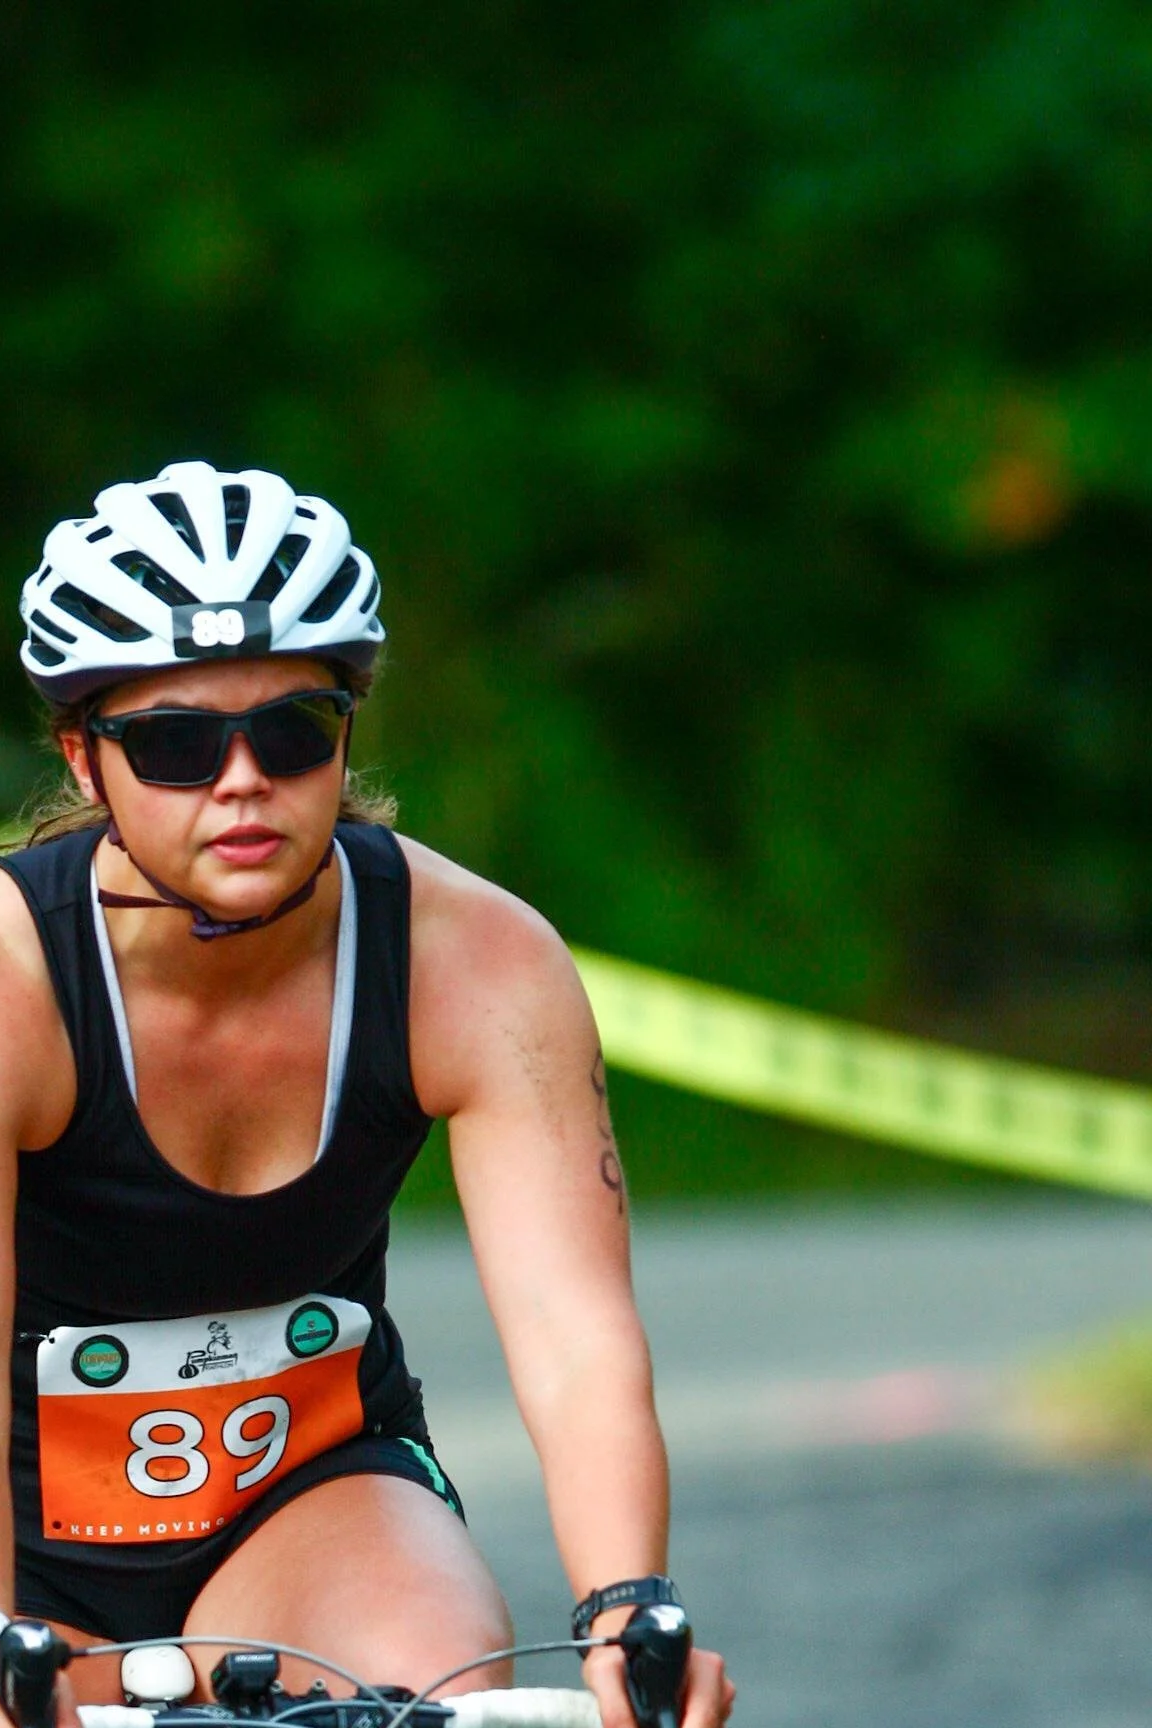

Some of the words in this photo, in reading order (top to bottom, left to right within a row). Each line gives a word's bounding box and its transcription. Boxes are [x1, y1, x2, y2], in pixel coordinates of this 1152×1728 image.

[192, 608, 245, 647] 89
[125, 1395, 291, 1497] 89
[70, 1523, 124, 1537] KEEP
[138, 1516, 225, 1536] MOVING
